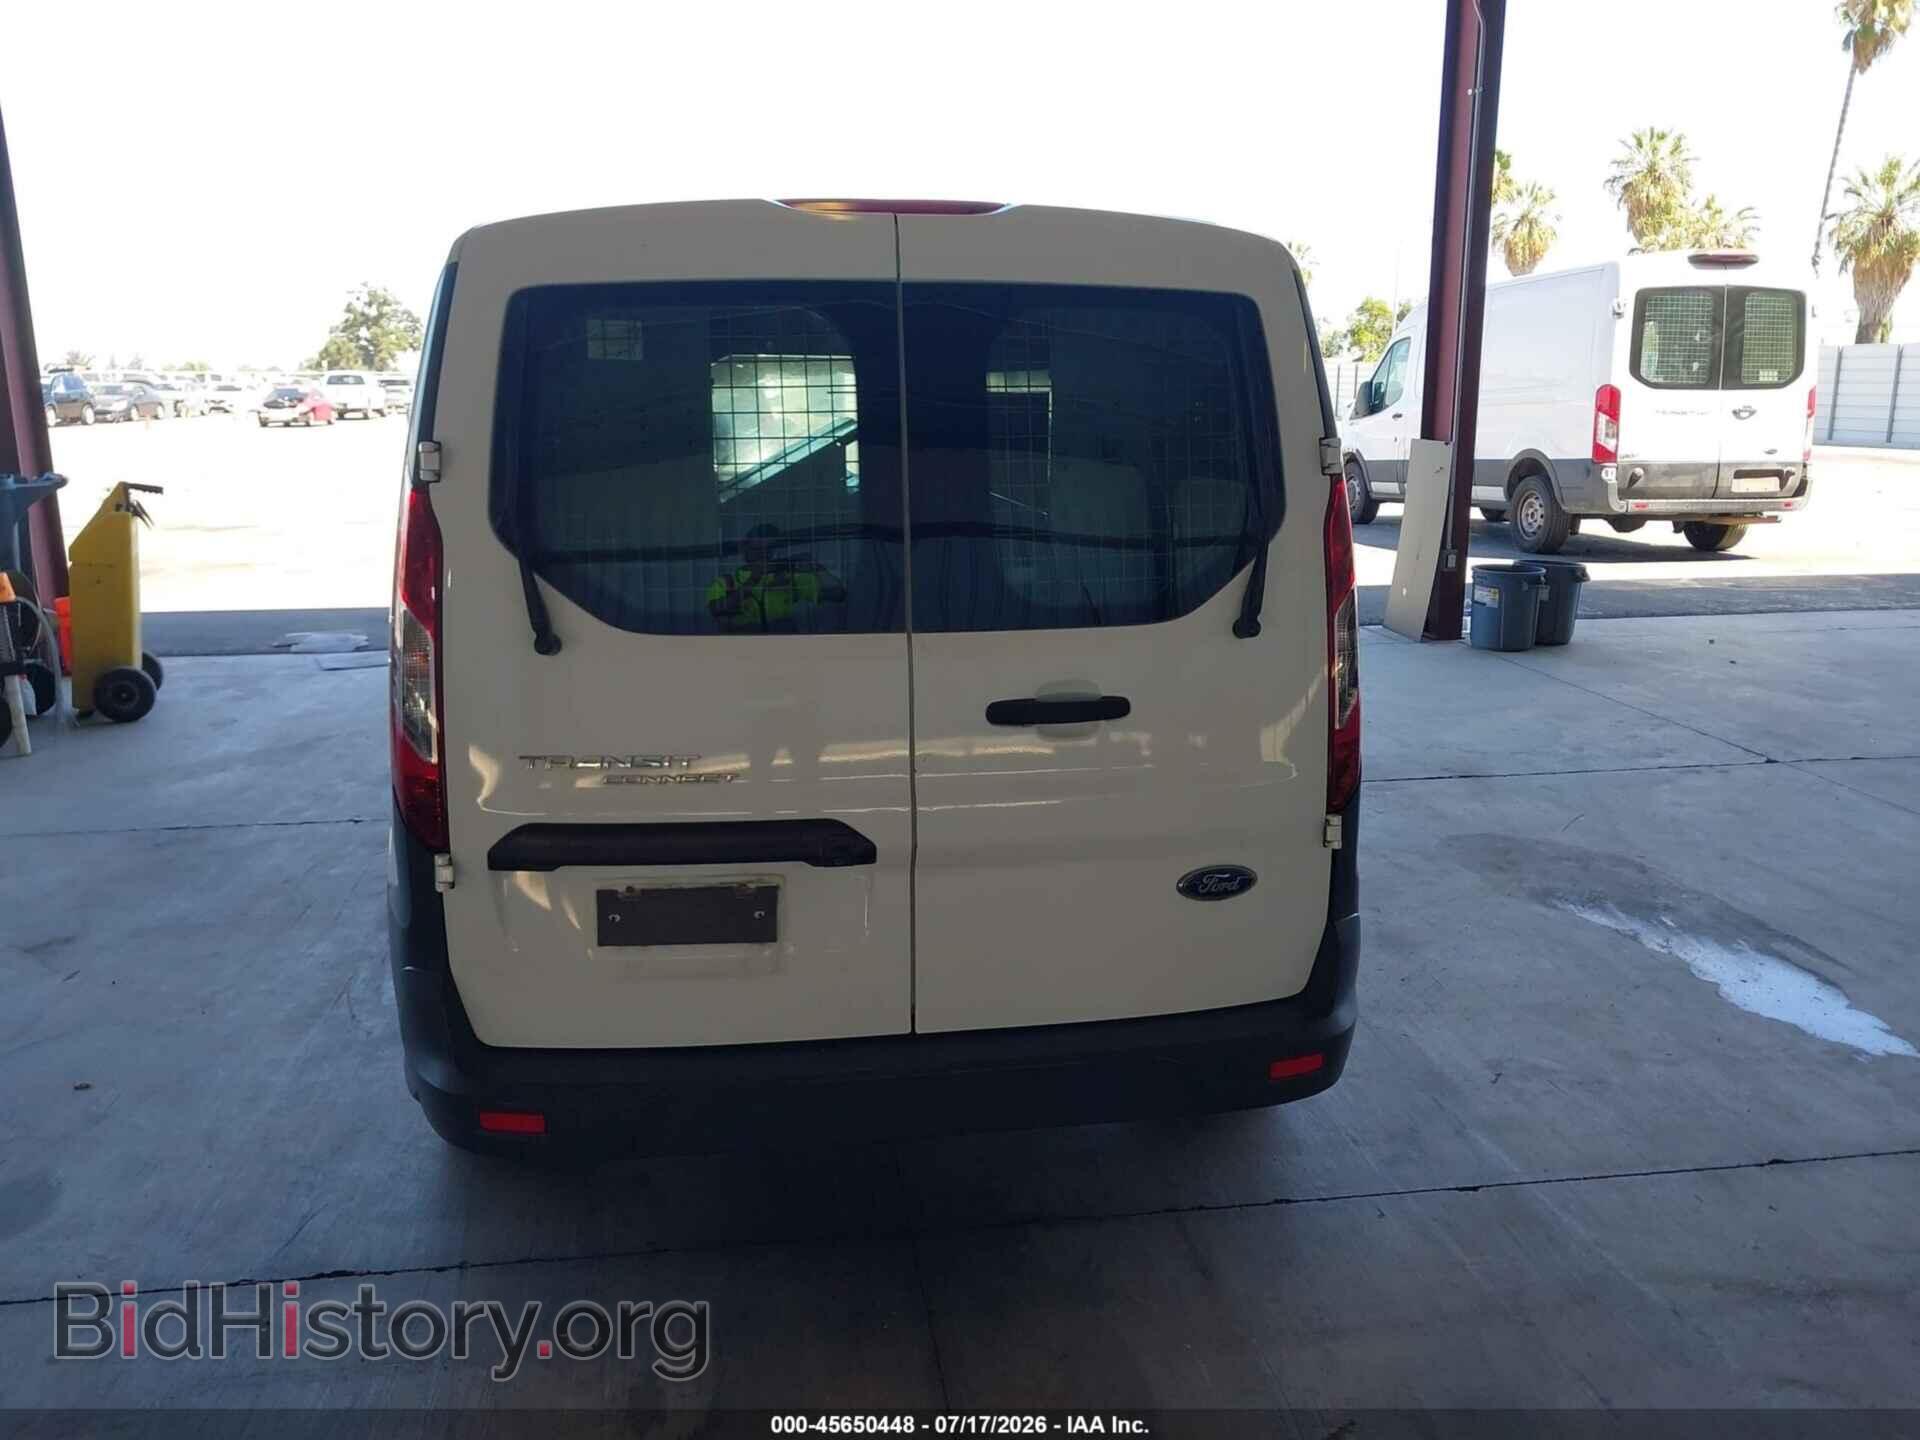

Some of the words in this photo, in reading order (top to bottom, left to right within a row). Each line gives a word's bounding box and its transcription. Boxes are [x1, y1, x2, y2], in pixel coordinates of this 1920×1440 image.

[518, 754, 702, 770] TRANSIT
[602, 772, 740, 785] CONNECT
[1198, 872, 1245, 893] Ford
